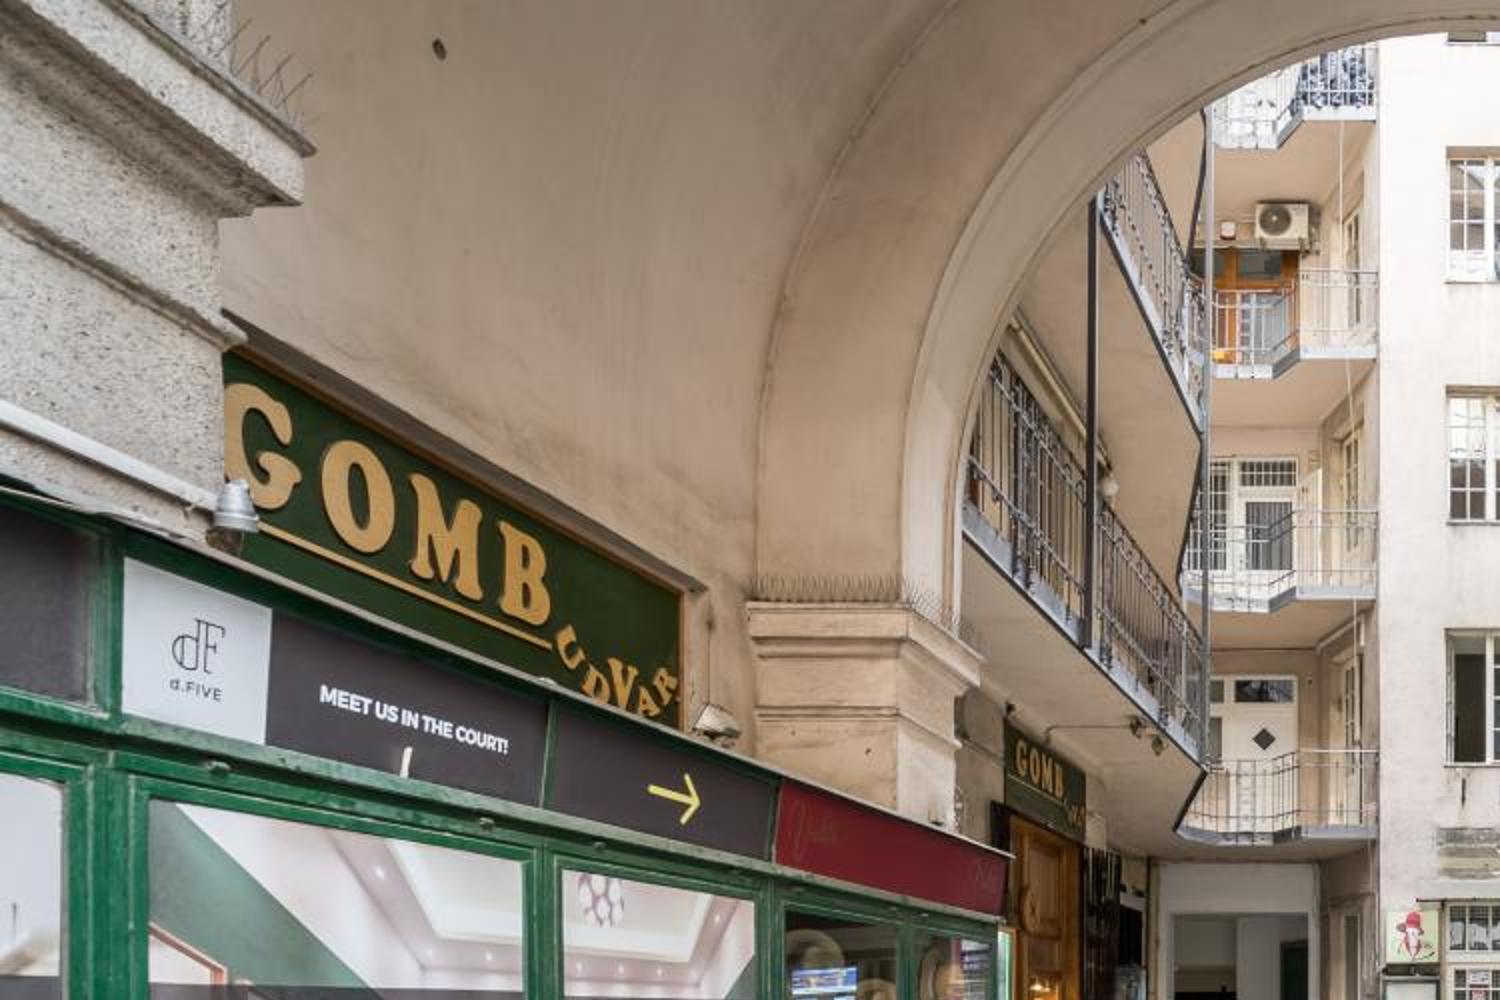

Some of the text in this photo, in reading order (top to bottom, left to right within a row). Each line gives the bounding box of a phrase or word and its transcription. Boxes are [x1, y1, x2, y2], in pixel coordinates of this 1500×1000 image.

[224, 382, 553, 628] GOMB
[319, 684, 510, 754] MEET US IN THE COURT!
